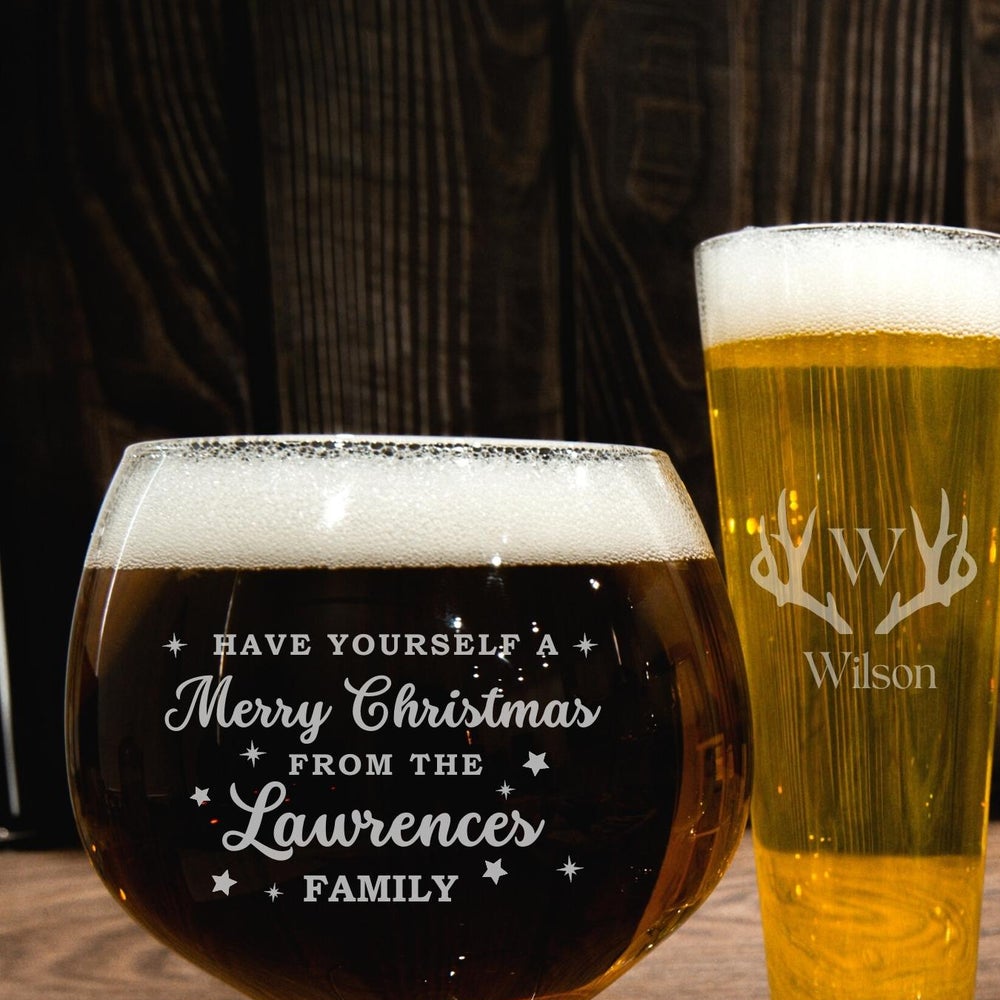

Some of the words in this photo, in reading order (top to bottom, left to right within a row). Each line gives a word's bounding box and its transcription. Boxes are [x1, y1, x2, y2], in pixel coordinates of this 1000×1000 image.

[827, 528, 907, 587] W
[213, 633, 312, 656] HAVE
[327, 633, 521, 656] YOURSELF
[536, 633, 559, 656] A
[803, 651, 938, 690] Wilson
[164, 674, 333, 745] Merry
[343, 674, 602, 732] Christmas
[288, 753, 394, 776] FROM
[409, 753, 483, 776] THE
[221, 780, 546, 861] Lawrences
[303, 874, 459, 902] FAMILY
